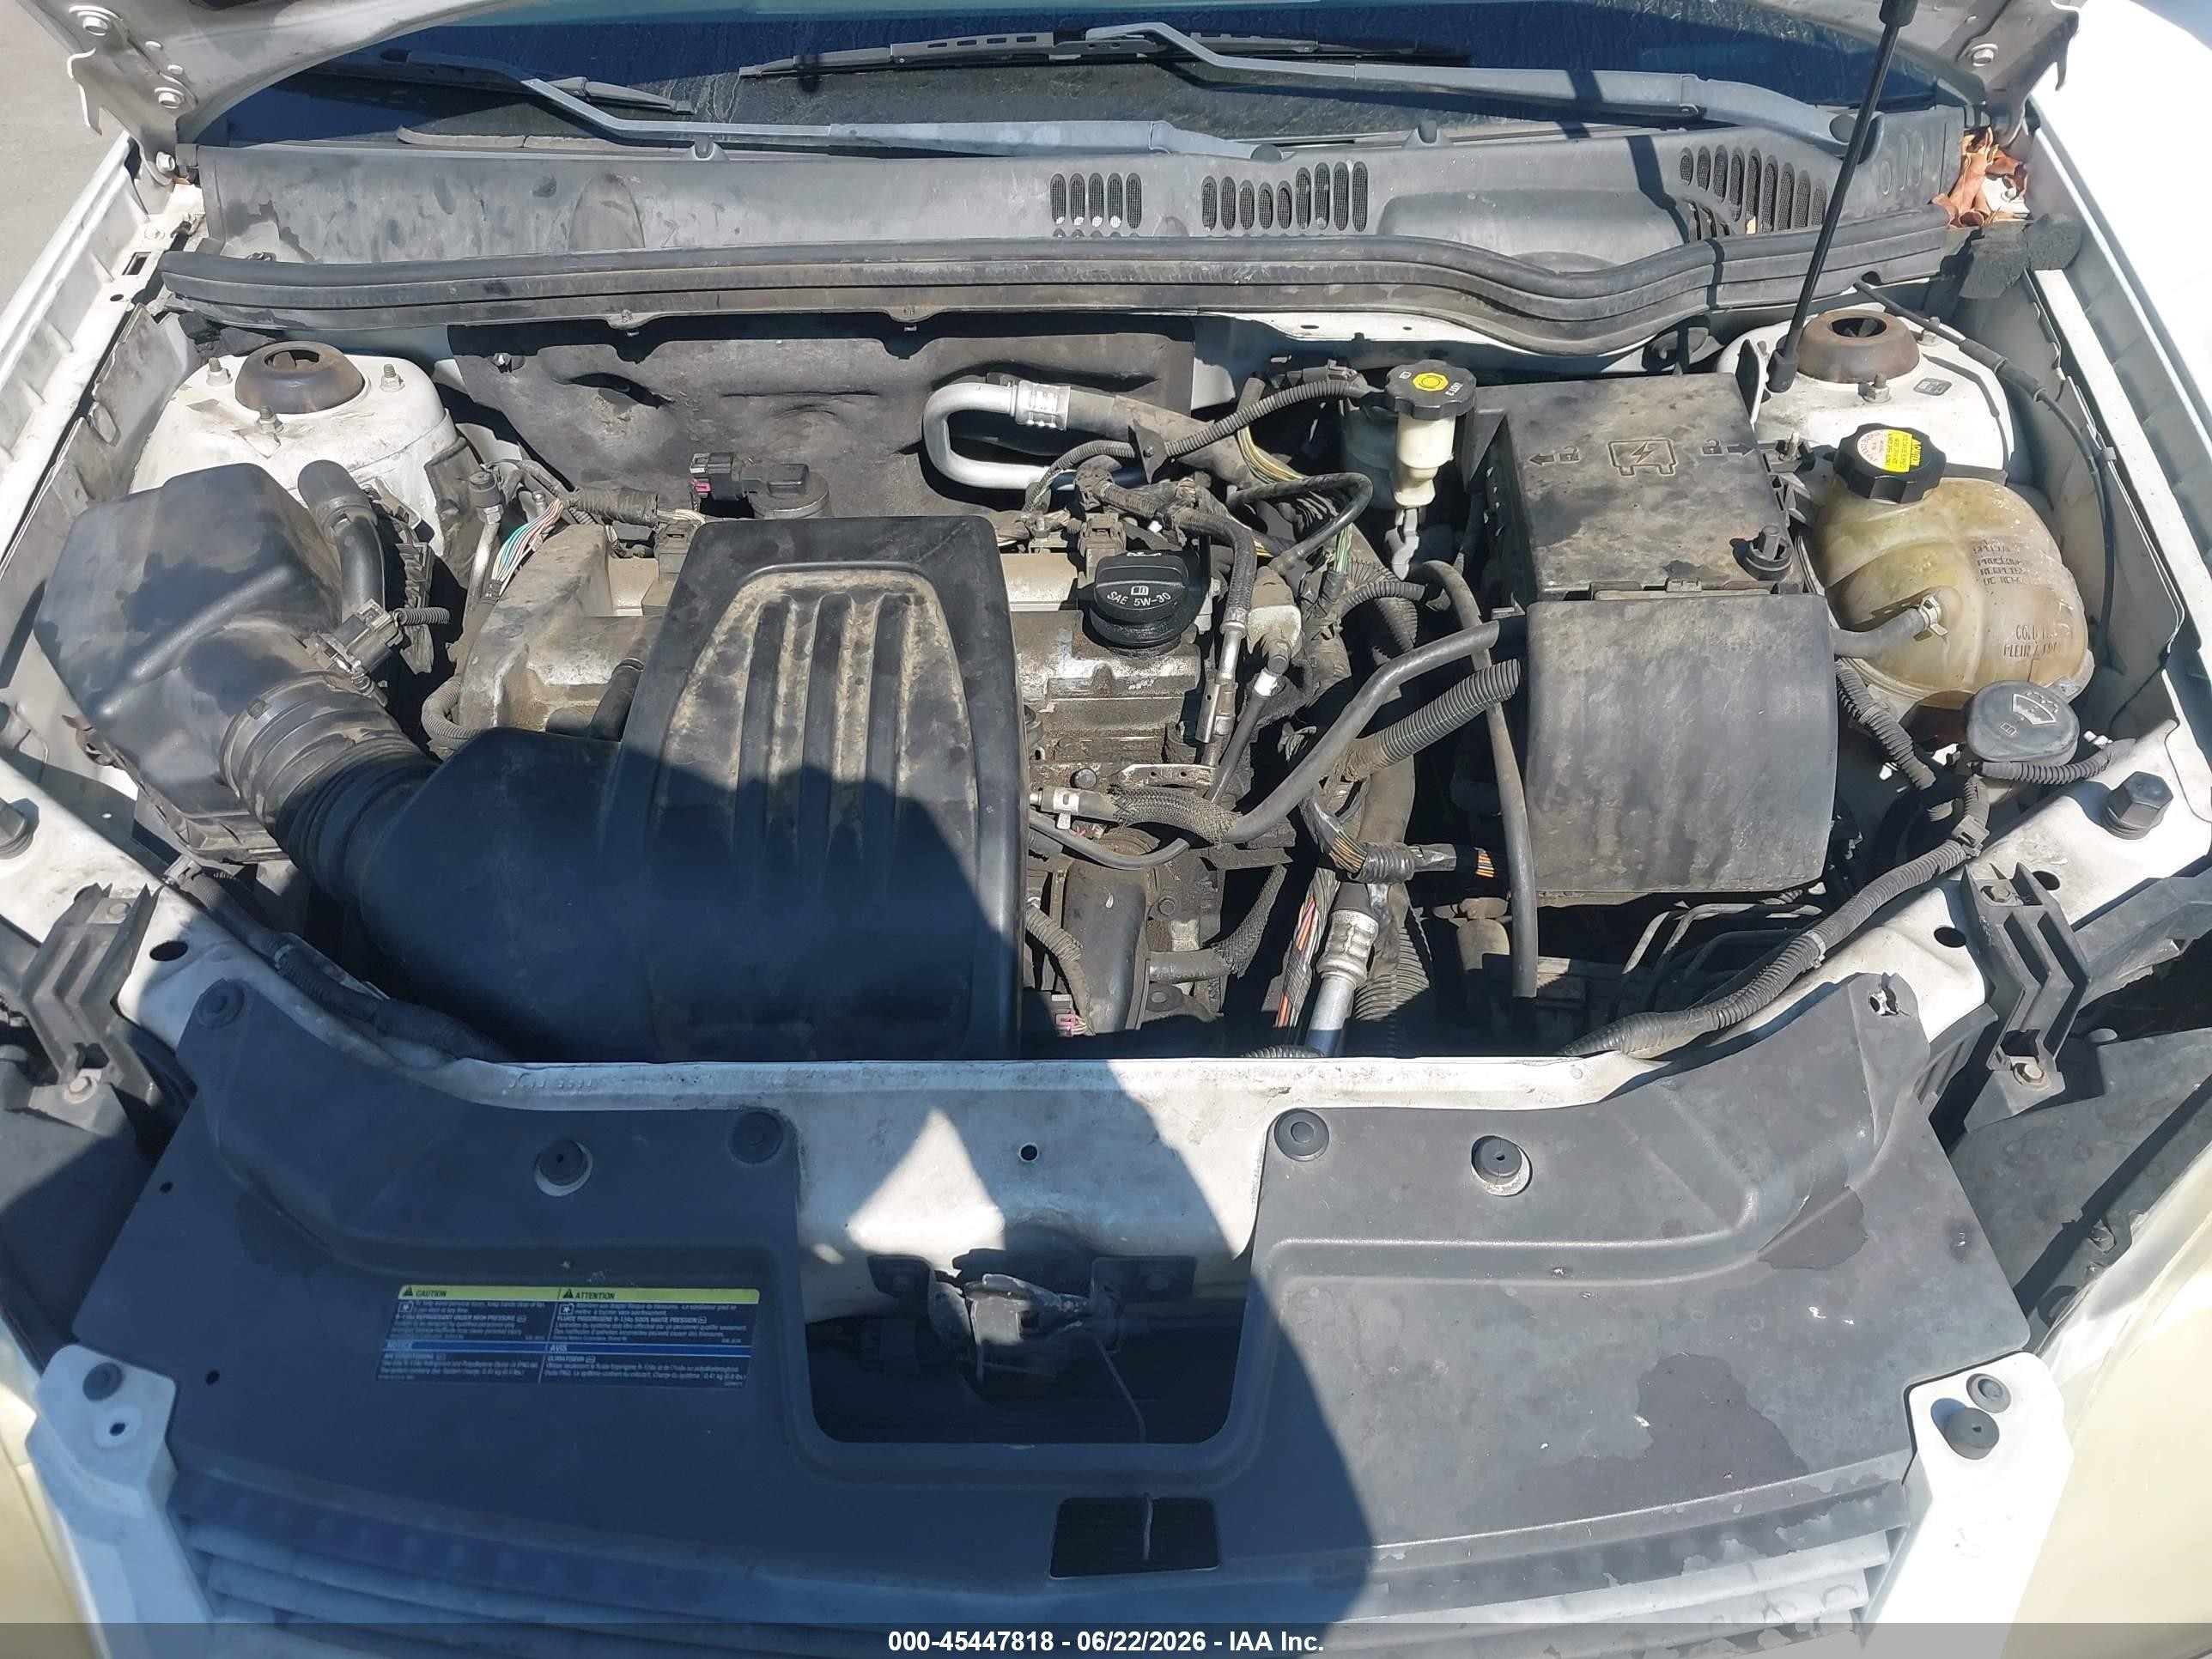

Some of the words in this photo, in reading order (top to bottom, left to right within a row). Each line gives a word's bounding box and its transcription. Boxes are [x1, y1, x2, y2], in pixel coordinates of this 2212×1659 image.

[1107, 591, 1129, 605] SAE
[1133, 592, 1171, 606] 5W-30
[574, 1291, 616, 1299] ATTENTION
[550, 1344, 568, 1352] AVIS
